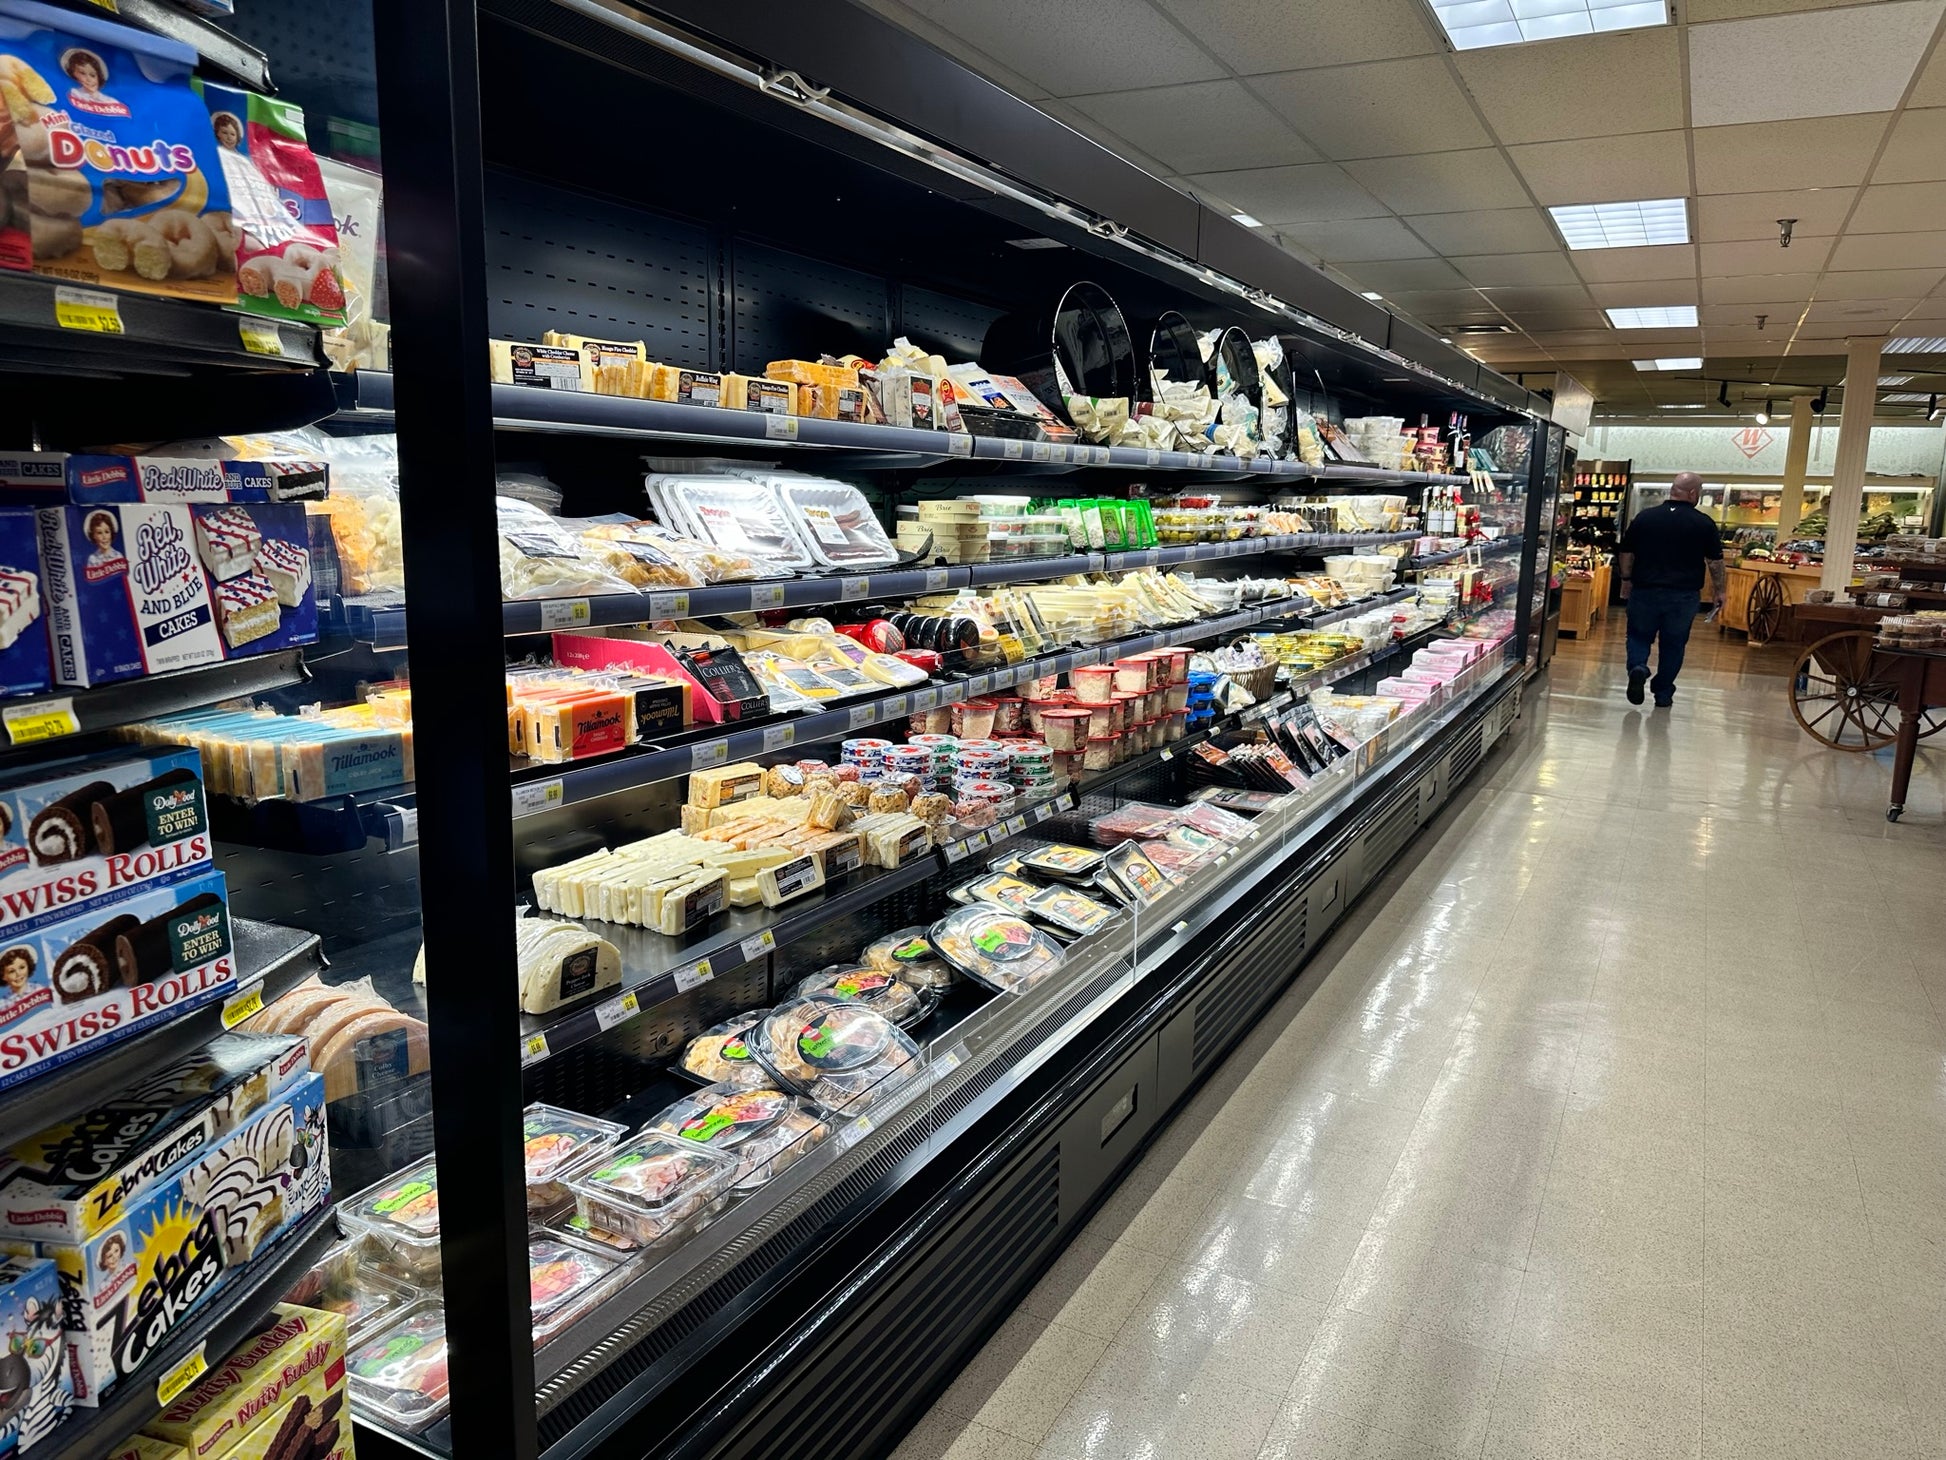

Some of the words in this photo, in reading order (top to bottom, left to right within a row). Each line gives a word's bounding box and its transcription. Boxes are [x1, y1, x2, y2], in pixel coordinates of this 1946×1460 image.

[71, 98, 92, 112] Little
[93, 103, 127, 115] Debbie
[41, 111, 69, 127] Mini
[70, 123, 115, 142] Glazed
[50, 130, 196, 174] Donuts
[23, 463, 60, 476] CAKES
[82, 472, 101, 485] Little
[101, 469, 128, 481] Debbie
[181, 466, 224, 491] White
[225, 473, 241, 481] AND
[225, 481, 243, 490] BLUE
[244, 477, 272, 488] CAKES
[137, 511, 183, 560] Red,
[86, 568, 104, 582] Little
[104, 561, 128, 578] Debbie
[134, 543, 191, 595] White
[140, 598, 171, 615] AND
[172, 575, 204, 610] BLUE
[159, 611, 198, 639] CAKES
[60, 635, 76, 680] CAKES
[702, 662, 741, 678] COLLIER'S
[578, 713, 621, 735] Tillamook
[640, 704, 679, 725] Tillamook
[331, 744, 396, 773] Tillamook
[157, 823, 174, 836] TO
[175, 815, 199, 833] WIN!
[158, 806, 196, 826] ENTER
[0, 870, 98, 922] WISS
[106, 835, 207, 889] ROLLS
[181, 948, 199, 962] TO
[199, 938, 223, 957] WIN!
[182, 930, 220, 951] ENTER
[565, 976, 582, 986] Pepper
[582, 972, 591, 981] Jack
[0, 1008, 18, 1025] ittle
[18, 992, 51, 1015] Debbie
[0, 1003, 122, 1070] SWISS
[129, 957, 232, 1018] ROLLS
[292, 1047, 306, 1067] Debbie
[374, 1063, 392, 1072] Colby
[29, 1060, 52, 1077] ROLLS
[371, 1068, 396, 1080] Cheese
[65, 1111, 159, 1181] Cakes
[93, 1155, 157, 1221] Zebra
[154, 1129, 203, 1173] Cakes
[10, 1211, 33, 1225] Little
[33, 1209, 65, 1224] Debbie
[94, 1285, 115, 1307] Little
[113, 1265, 137, 1293] Debbie
[96, 1208, 218, 1360] Zebra
[122, 1253, 219, 1375] Cakes
[160, 1369, 243, 1423] Nutty
[237, 1316, 309, 1371] Buddy
[71, 1366, 87, 1398] Debbie
[235, 1379, 284, 1429] Nutty
[281, 1340, 333, 1389] Buddy
[214, 1420, 232, 1440] Debbie
